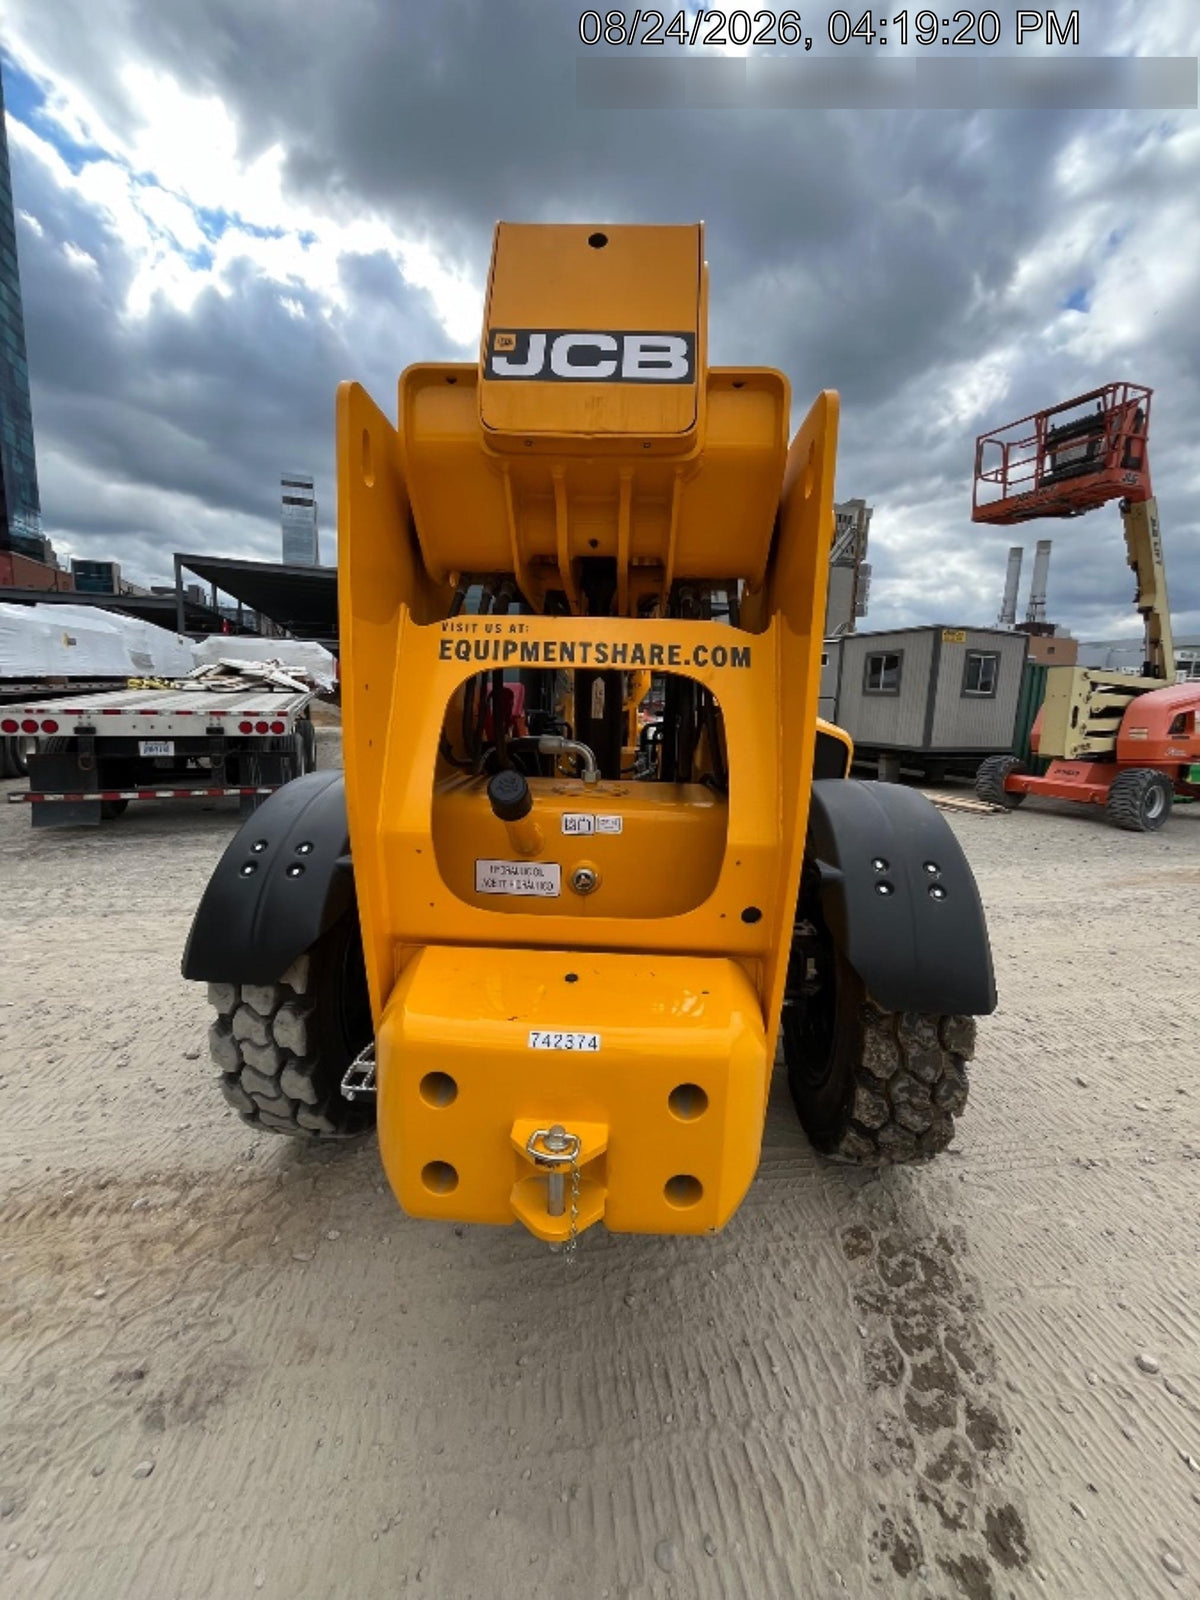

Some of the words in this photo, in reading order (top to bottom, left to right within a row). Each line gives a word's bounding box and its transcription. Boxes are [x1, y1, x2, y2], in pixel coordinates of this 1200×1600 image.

[492, 334, 689, 379] JCB
[441, 622, 478, 633] VISIT
[485, 623, 502, 633] US
[509, 623, 529, 634] AT:
[439, 639, 751, 668] EQUIPMENTSHARE.COM
[531, 1032, 597, 1050] 742374
